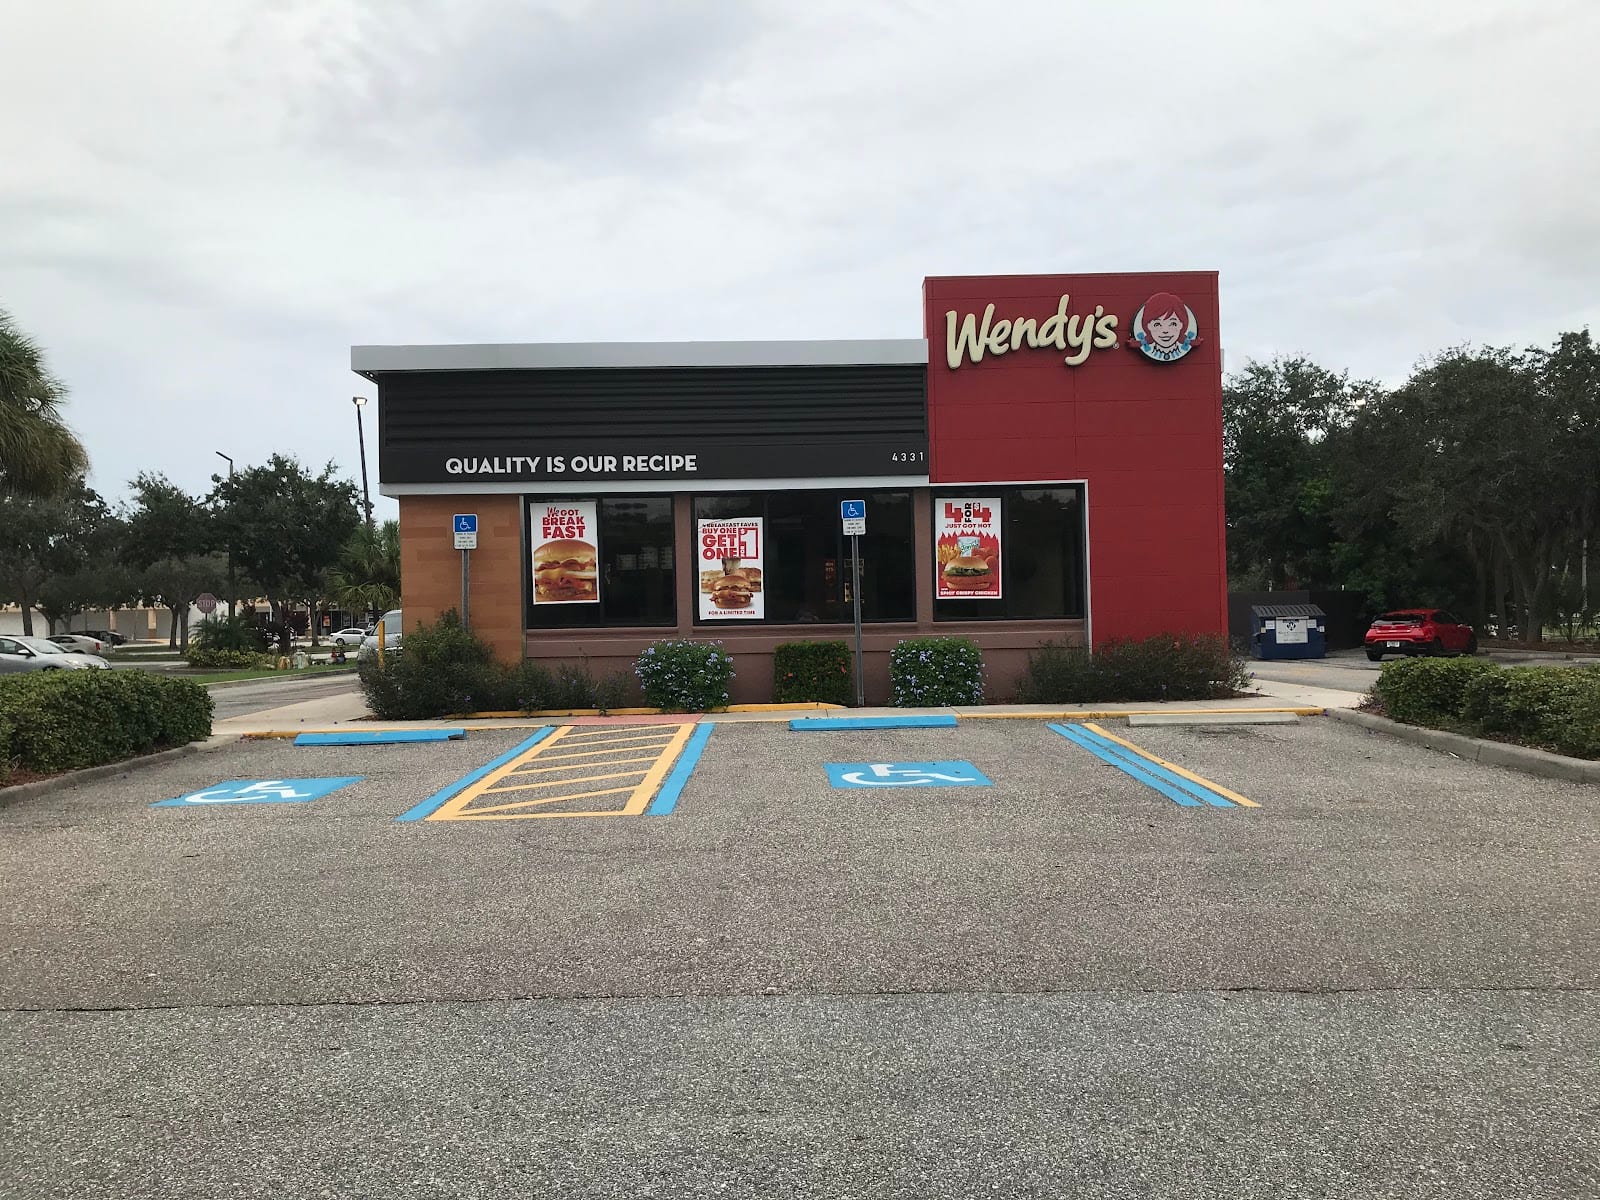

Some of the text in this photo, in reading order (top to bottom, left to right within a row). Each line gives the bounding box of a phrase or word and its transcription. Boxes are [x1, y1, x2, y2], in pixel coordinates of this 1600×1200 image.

[946, 294, 1118, 369] Wendy's
[891, 451, 924, 462] 4331
[445, 454, 698, 475] QUALITY IS OUR RECIPE
[944, 502, 964, 523] 4
[964, 502, 972, 523] FOR
[542, 516, 584, 525] BREAK
[542, 526, 585, 538] FAST
[702, 534, 737, 548] GET
[702, 547, 738, 560] ONE
[199, 600, 215, 608] STOP
